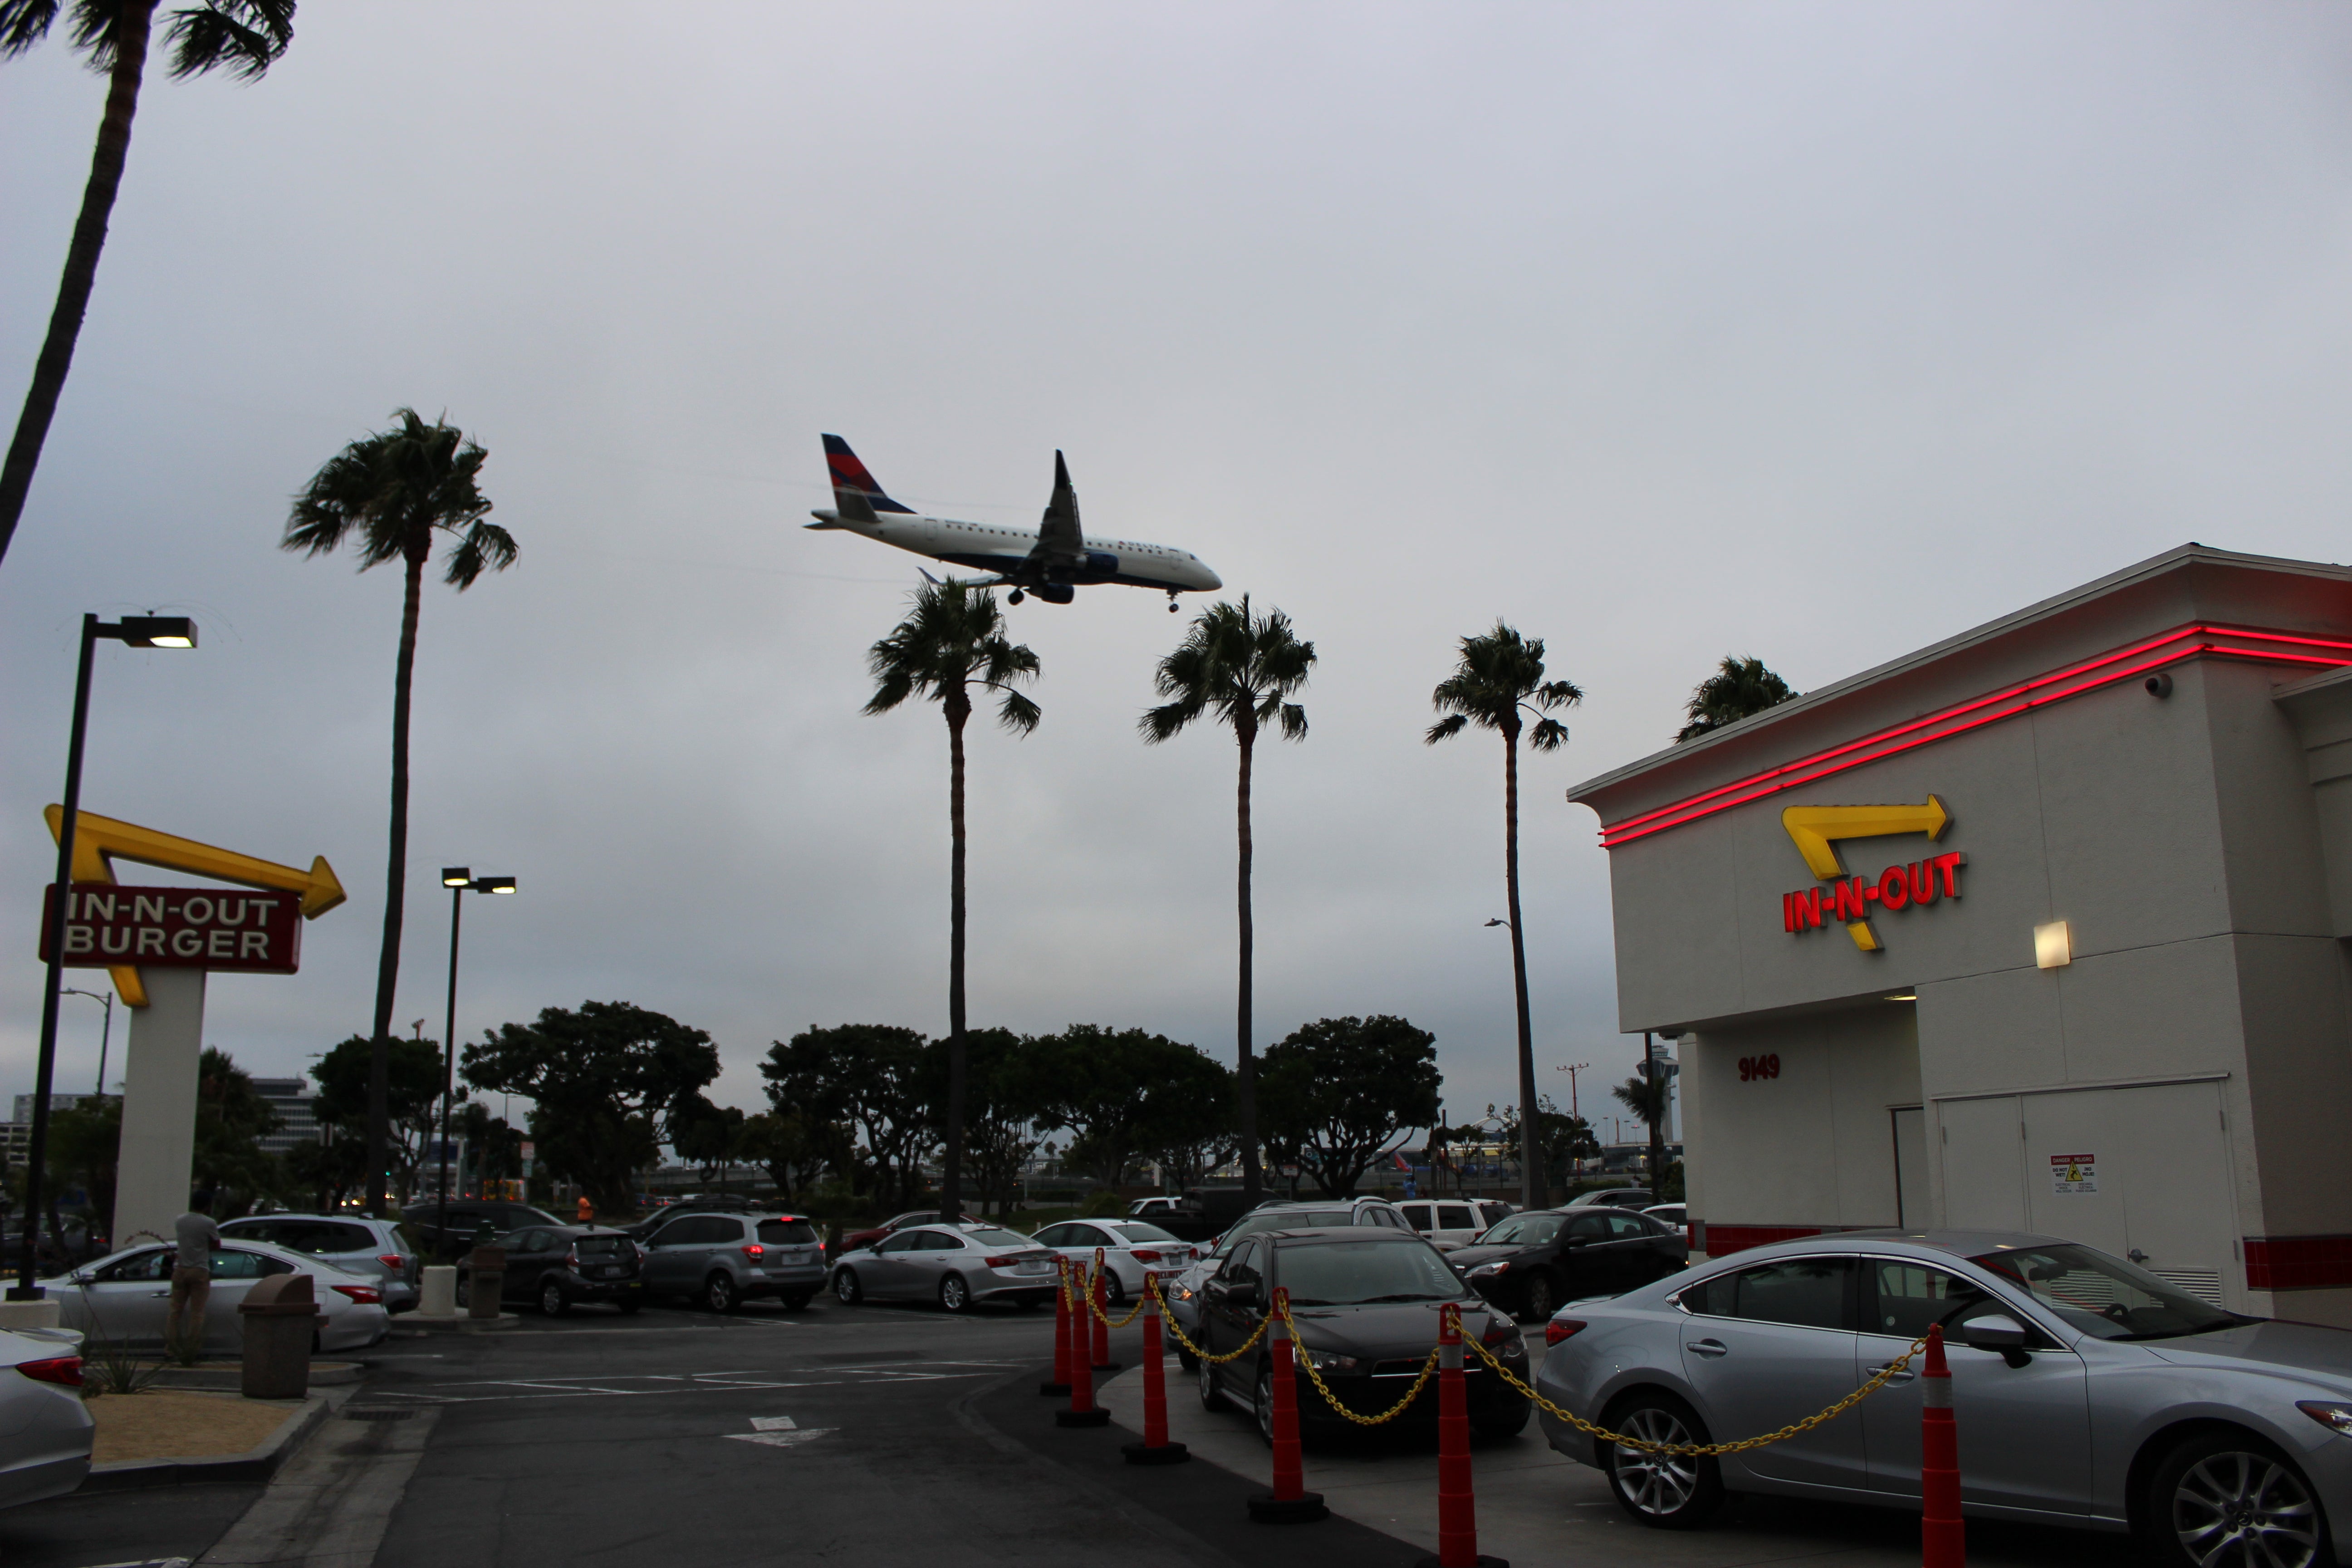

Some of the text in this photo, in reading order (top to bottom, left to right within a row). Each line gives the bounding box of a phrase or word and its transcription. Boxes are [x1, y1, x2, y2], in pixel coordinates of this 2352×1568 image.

[67, 893, 279, 926] IN-N-OUT
[1783, 852, 1965, 933] IN-N-OUT
[64, 925, 270, 960] BURGER
[1738, 1054, 1780, 1082] 9149
